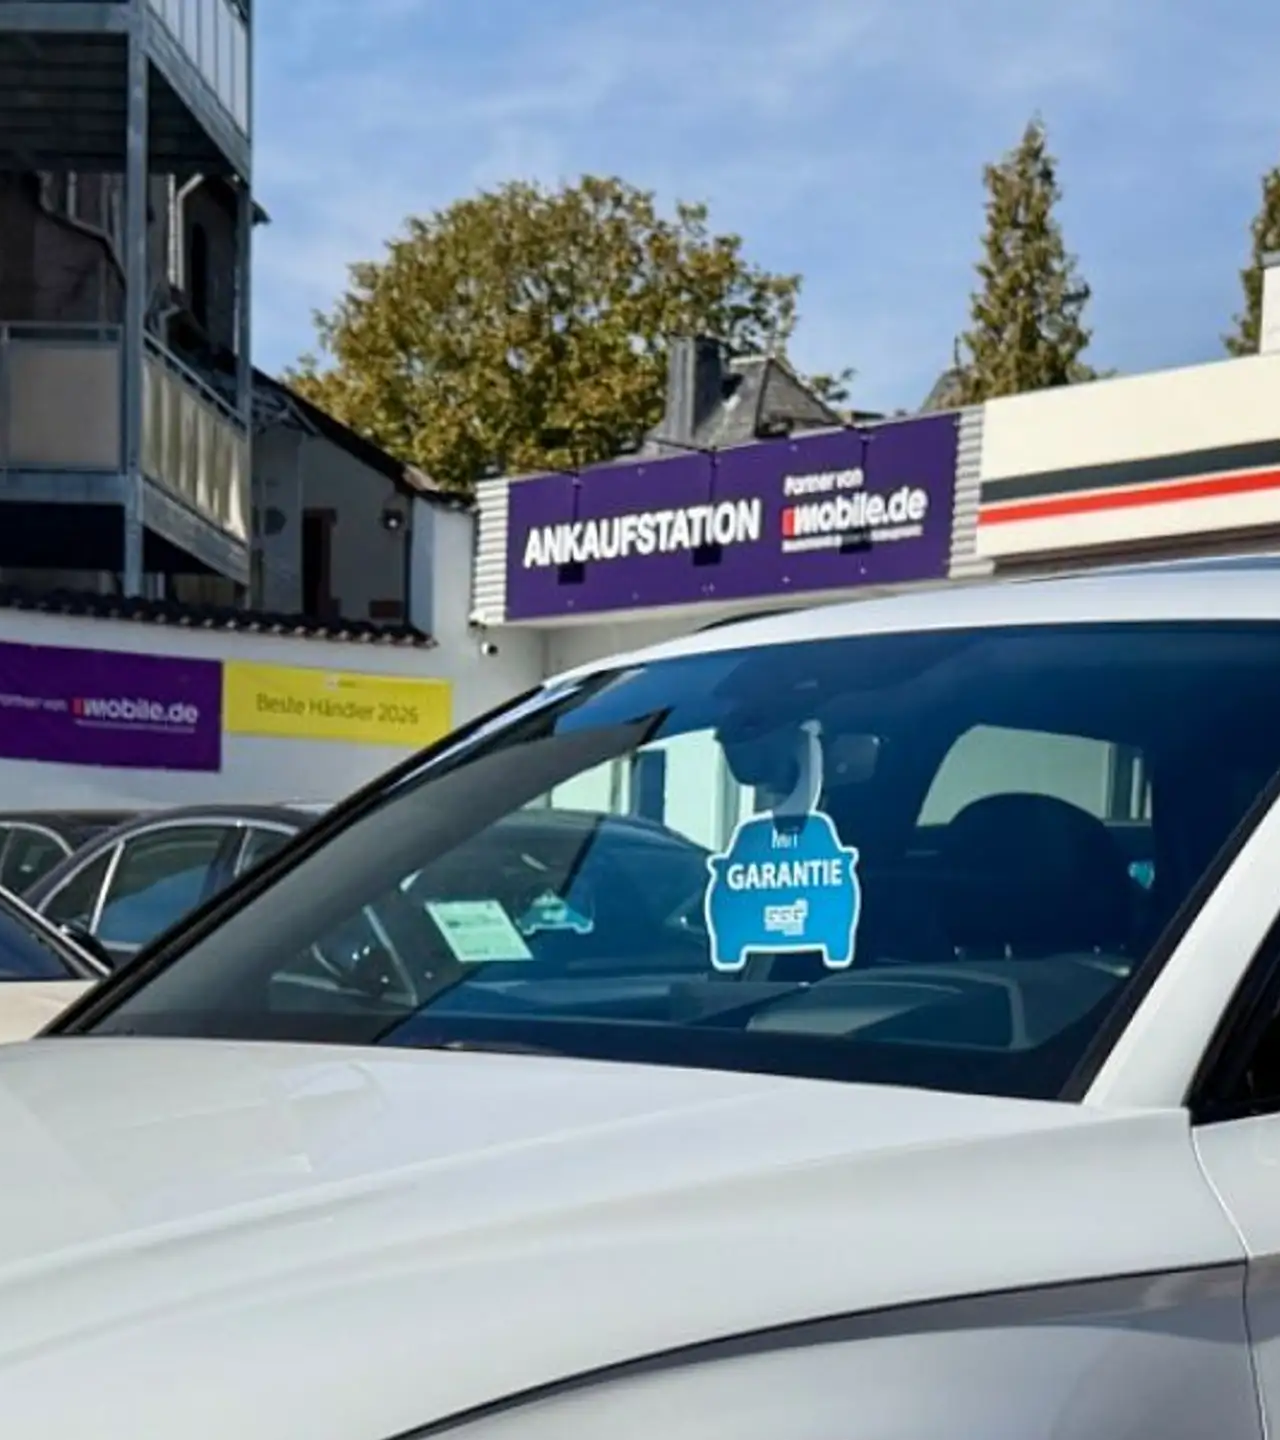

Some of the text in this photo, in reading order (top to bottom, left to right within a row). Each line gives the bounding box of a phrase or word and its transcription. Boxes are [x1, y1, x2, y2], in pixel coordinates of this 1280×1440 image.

[783, 486, 928, 537] mobile.de
[524, 499, 760, 568] ANKAUFSTATION
[73, 697, 198, 724] mobile.de
[256, 692, 306, 716] Beste
[727, 859, 843, 890] GARANTIE
